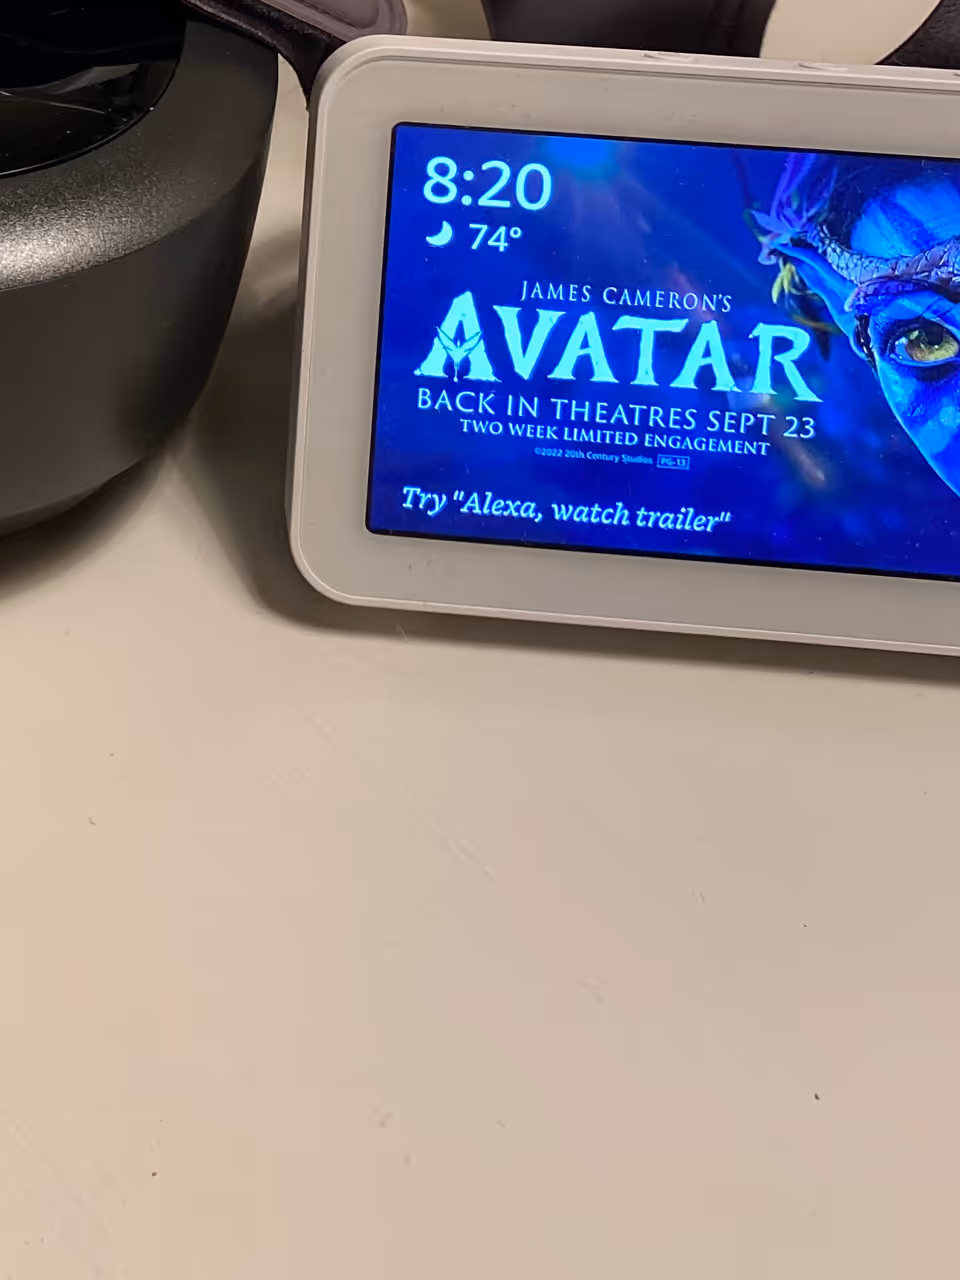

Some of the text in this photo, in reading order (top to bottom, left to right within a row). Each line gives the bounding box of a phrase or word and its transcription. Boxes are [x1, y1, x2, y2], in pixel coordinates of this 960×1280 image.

[423, 156, 552, 211] 8:20
[469, 223, 523, 252] 74°
[520, 280, 732, 313] JAMES CAMERON'S
[413, 290, 824, 402] AVATAR
[417, 387, 816, 439] BACK IN THEATRES SEPT 23
[460, 418, 772, 456] TWO WEEK LIMITED ENGAGEMENT
[564, 449, 585, 459] 20th
[586, 451, 620, 464] Century
[621, 454, 654, 465] Studios
[402, 485, 732, 533] Try "Alexa, watch trailer"
